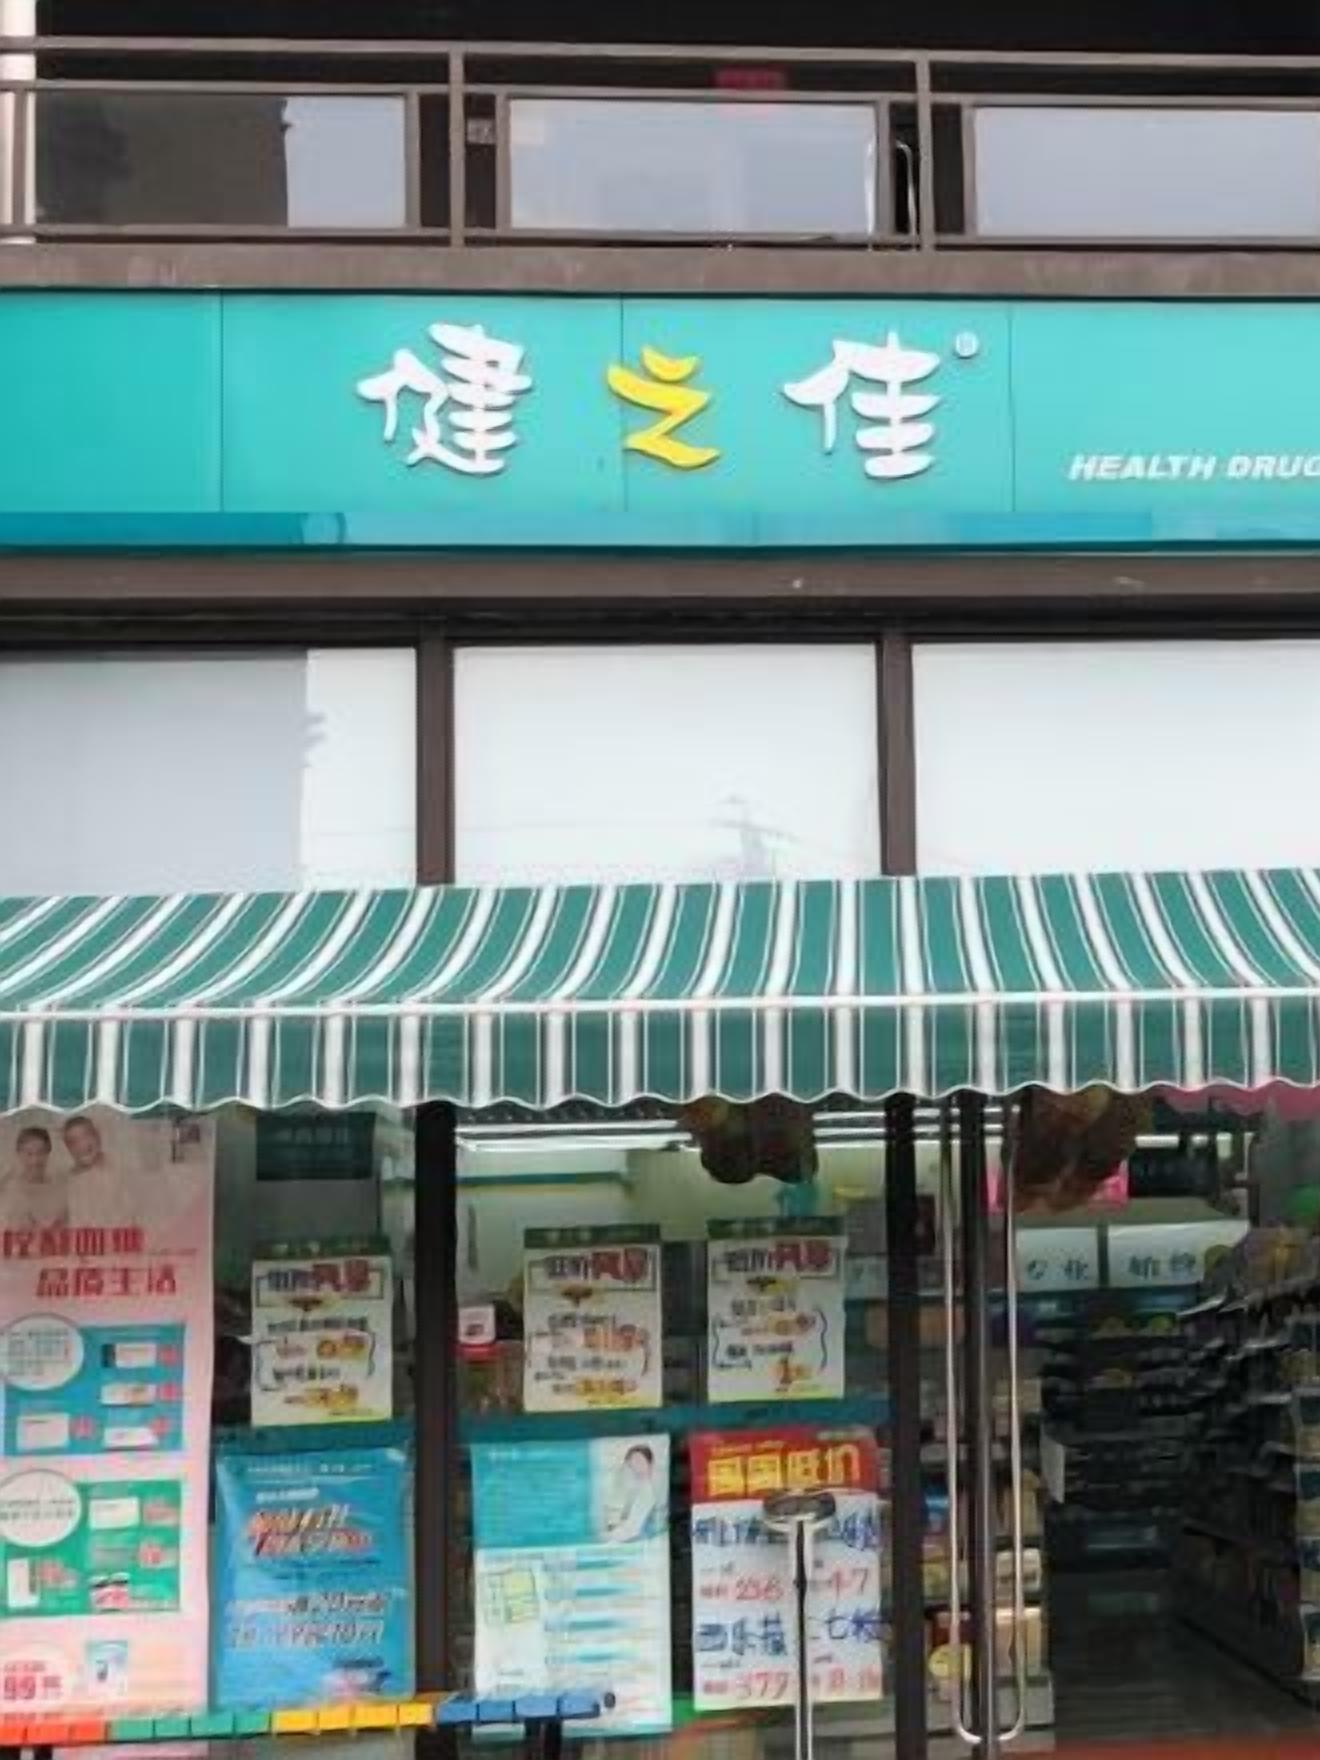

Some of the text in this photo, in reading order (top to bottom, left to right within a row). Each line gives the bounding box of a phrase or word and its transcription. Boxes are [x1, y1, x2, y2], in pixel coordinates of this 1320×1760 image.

[357, 323, 941, 479] 健之佳
[1068, 453, 1217, 480] HEALTH
